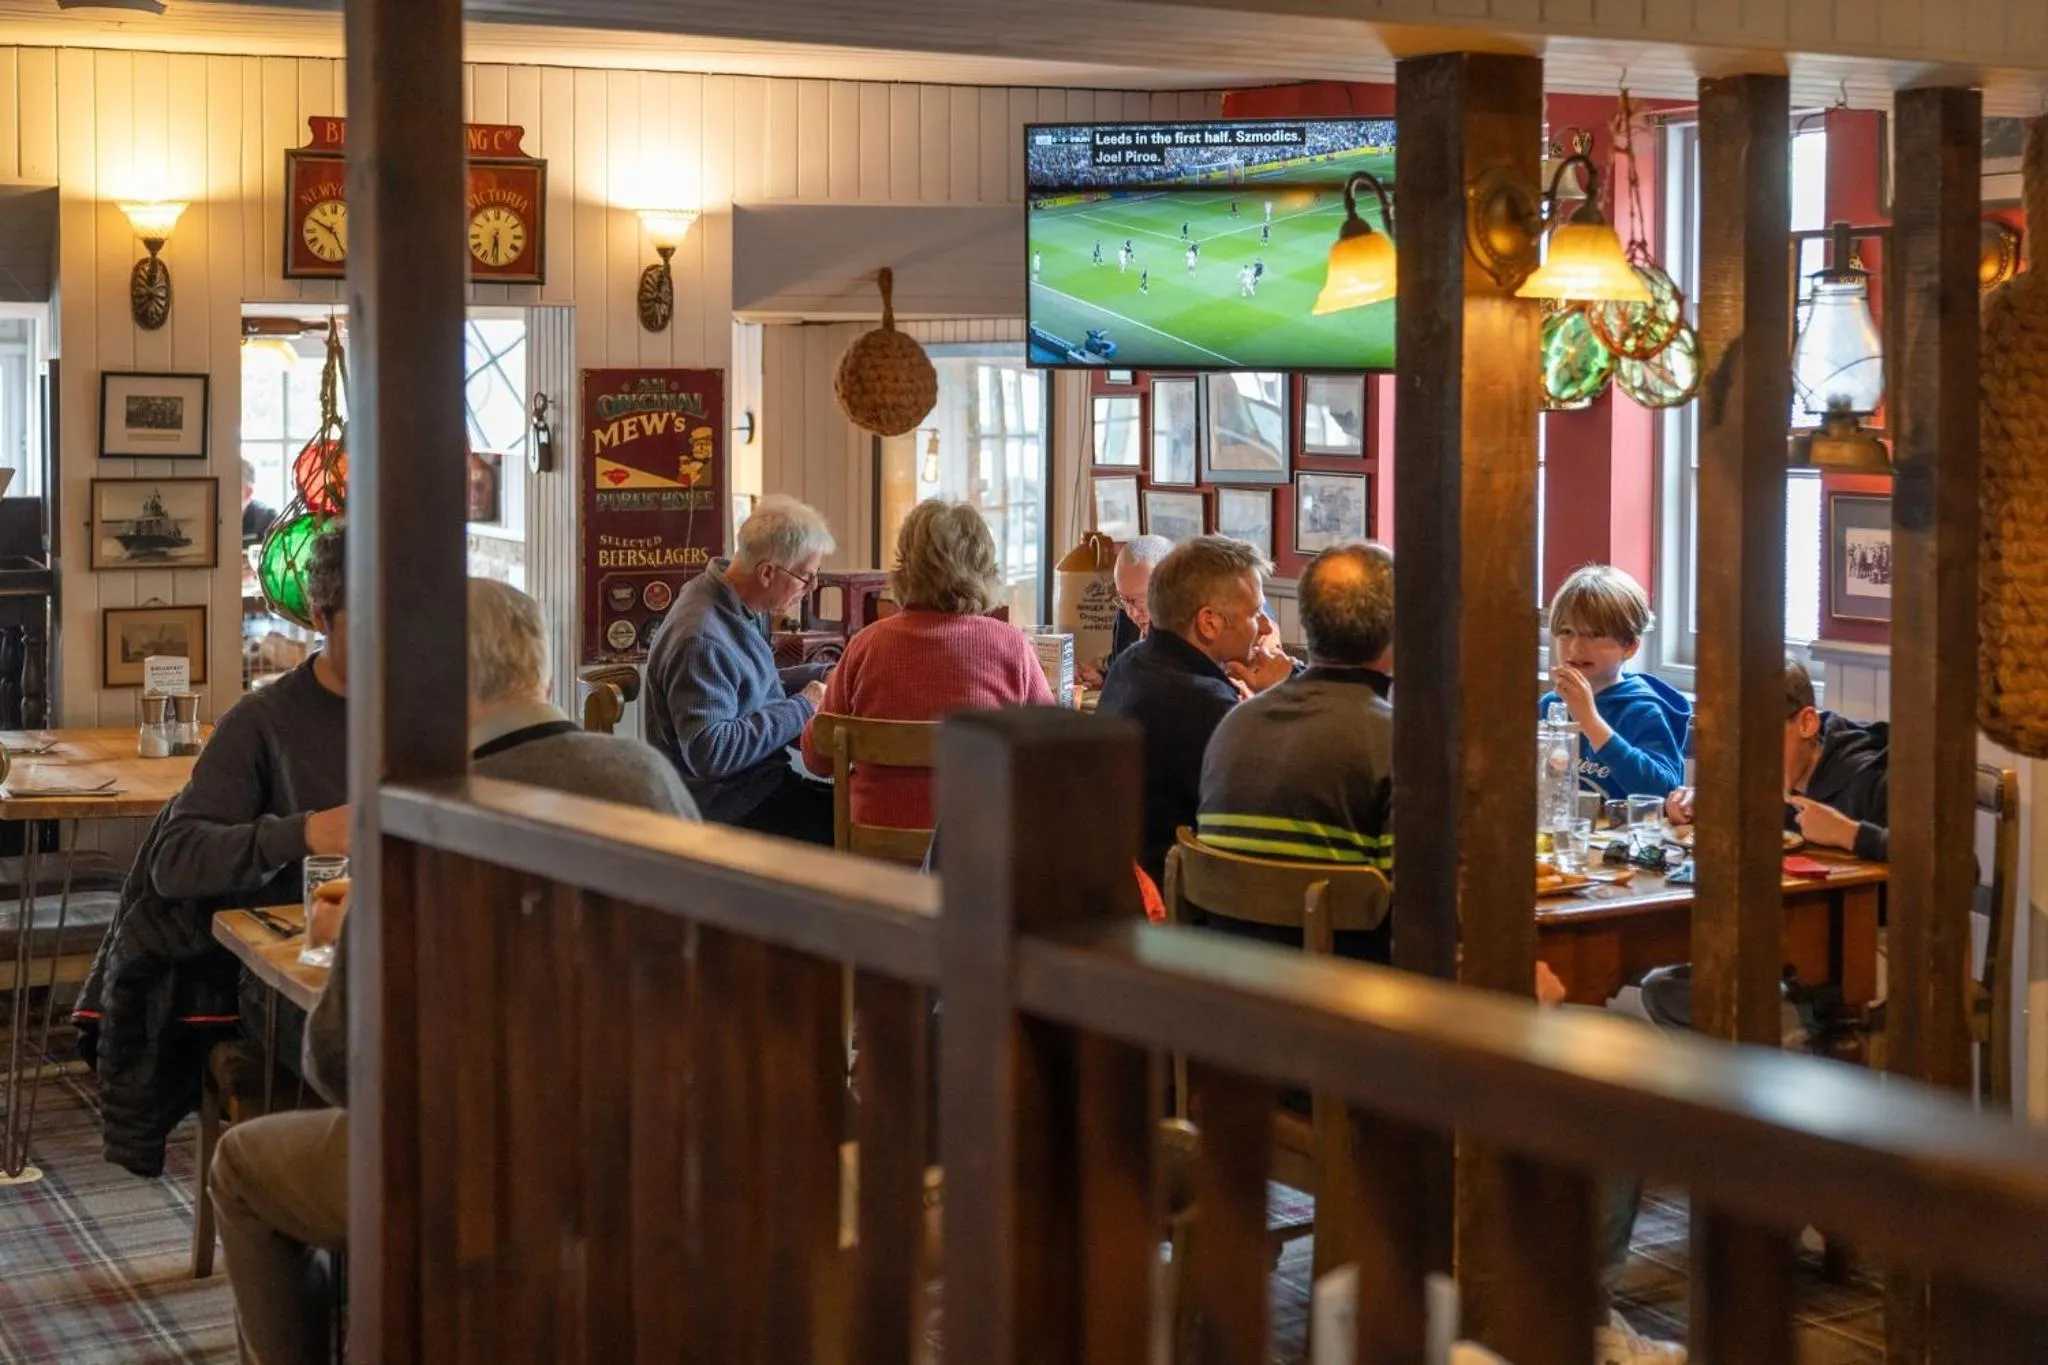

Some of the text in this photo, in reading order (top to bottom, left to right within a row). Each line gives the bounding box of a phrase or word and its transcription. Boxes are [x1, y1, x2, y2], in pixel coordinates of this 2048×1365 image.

[1095, 133, 1132, 145] Leeds
[1135, 132, 1148, 144] in
[1150, 132, 1172, 144] the
[1175, 131, 1201, 144] first
[1204, 131, 1232, 143] half.
[1235, 130, 1301, 143] Szmodics.
[1095, 151, 1161, 163] Joel Piroe.
[467, 188, 529, 214] VICTORIA
[596, 391, 708, 420] ORIGINAL
[591, 411, 687, 456] MEW's
[596, 490, 715, 512] PUBLIC HOUSE
[600, 534, 663, 549] SELECTED
